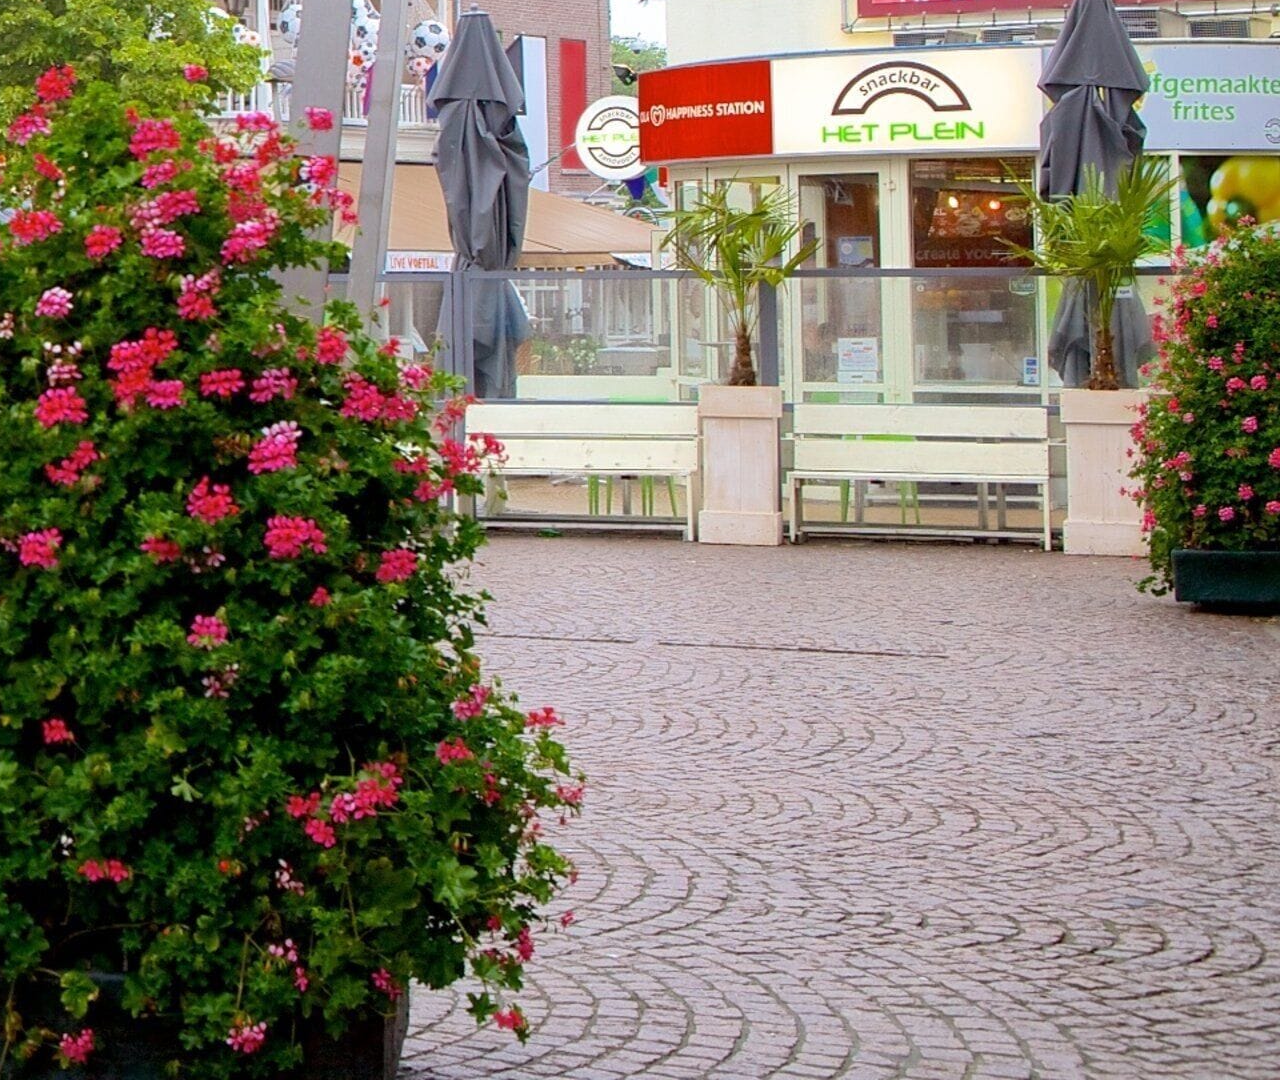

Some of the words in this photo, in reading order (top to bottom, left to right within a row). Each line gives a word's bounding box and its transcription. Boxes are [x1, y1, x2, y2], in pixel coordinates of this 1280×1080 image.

[859, 70, 941, 96] snackbar
[666, 103, 714, 120] HAPPINESS
[716, 101, 765, 115] STATION
[1173, 101, 1235, 120] frites
[822, 123, 879, 143] HET
[890, 121, 984, 141] PLEIN
